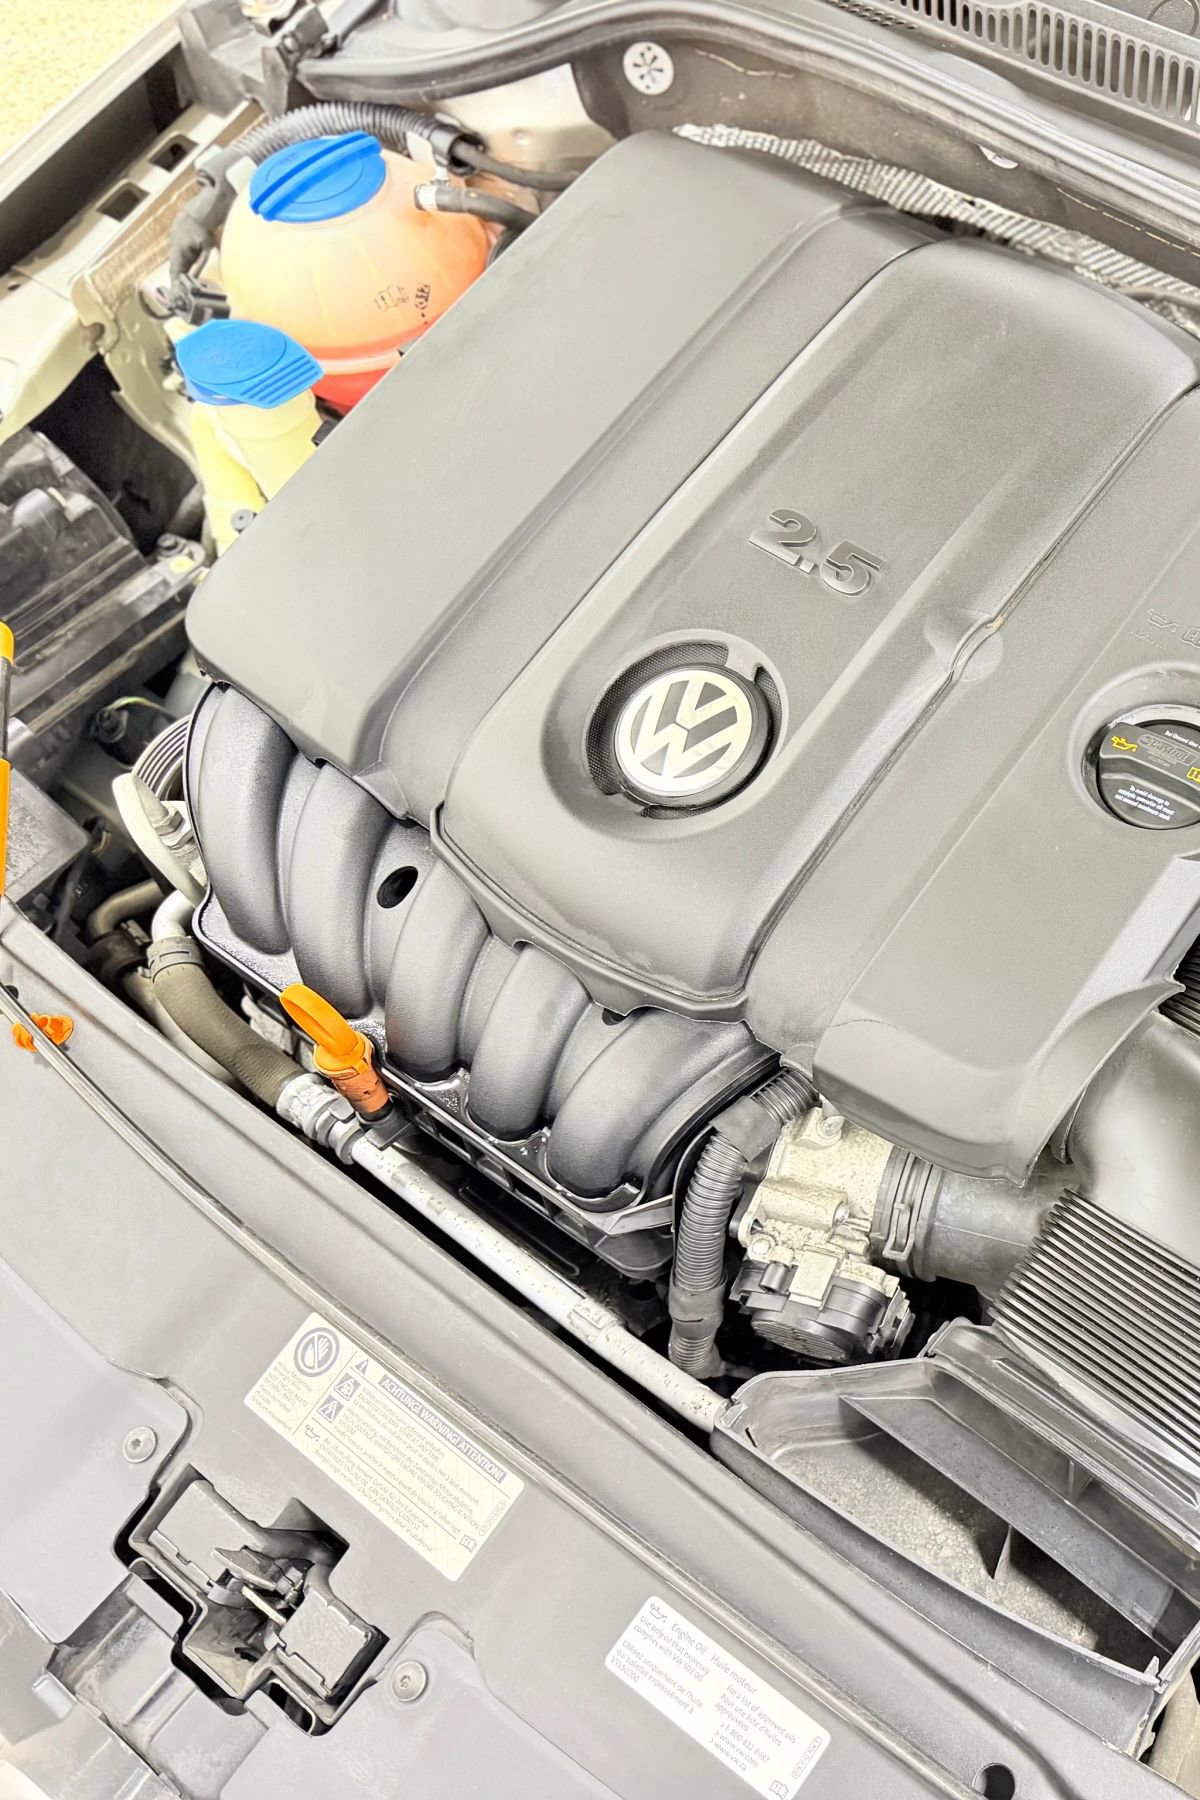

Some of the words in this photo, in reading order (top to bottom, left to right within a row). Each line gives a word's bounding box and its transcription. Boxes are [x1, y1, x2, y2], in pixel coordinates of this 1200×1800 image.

[748, 508, 888, 597] 2.5
[382, 1379, 422, 1413] ACHTUNG!
[421, 1409, 461, 1444] WARNING!
[458, 1441, 503, 1478] ATTENTION!
[633, 1624, 659, 1647] complies
[658, 1644, 673, 1657] with
[672, 1654, 685, 1666] VW
[682, 1662, 695, 1675] 502
[640, 1615, 652, 1628] Use
[650, 1625, 665, 1639] only
[663, 1635, 673, 1644] oil
[671, 1640, 685, 1655] that
[671, 1622, 696, 1646] Engine
[695, 1642, 708, 1655] Oil
[710, 1654, 730, 1674] Huile
[729, 1671, 757, 1694] moteur
[720, 1693, 735, 1707] Pour
[734, 1705, 747, 1718] une
[745, 1713, 760, 1728] liste
[726, 1684, 737, 1696] For
[741, 1695, 752, 1708] list
[750, 1705, 761, 1713] of
[757, 1711, 787, 1735] approved
